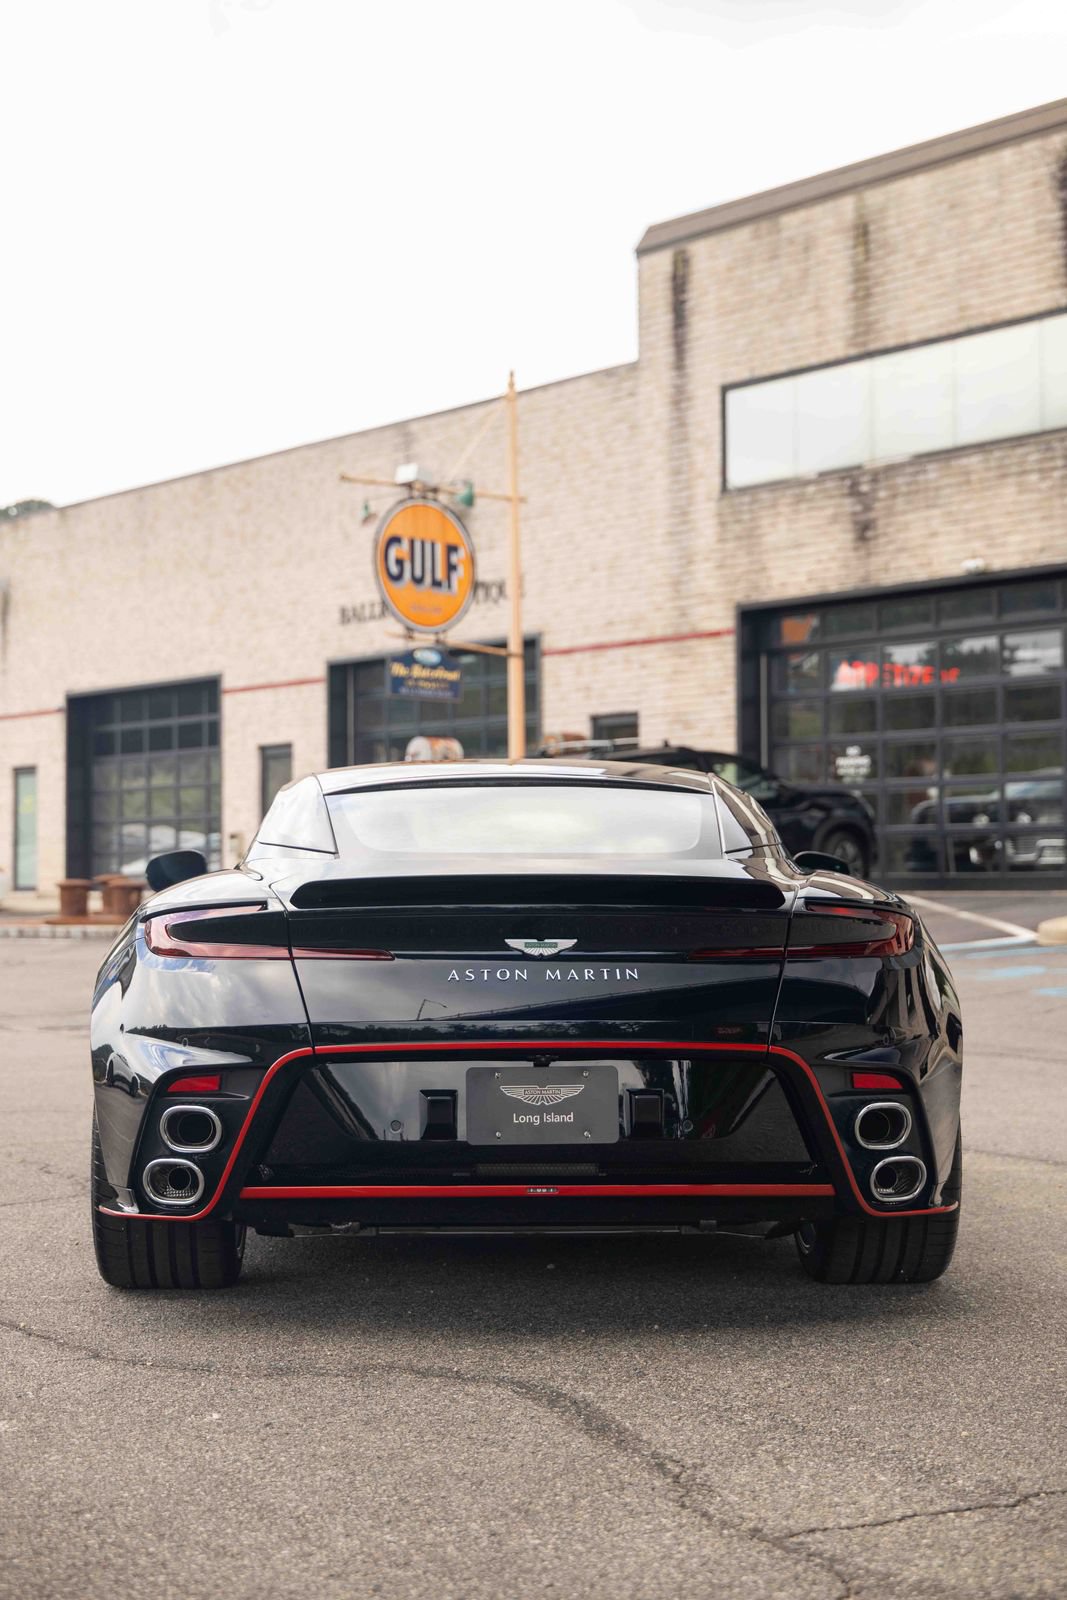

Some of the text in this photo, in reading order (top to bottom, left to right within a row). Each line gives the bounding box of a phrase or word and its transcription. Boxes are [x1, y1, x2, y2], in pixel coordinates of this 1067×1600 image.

[384, 535, 462, 593] GULF
[447, 968, 639, 981] ASTON MARTIN
[513, 1111, 574, 1126] Long Island
